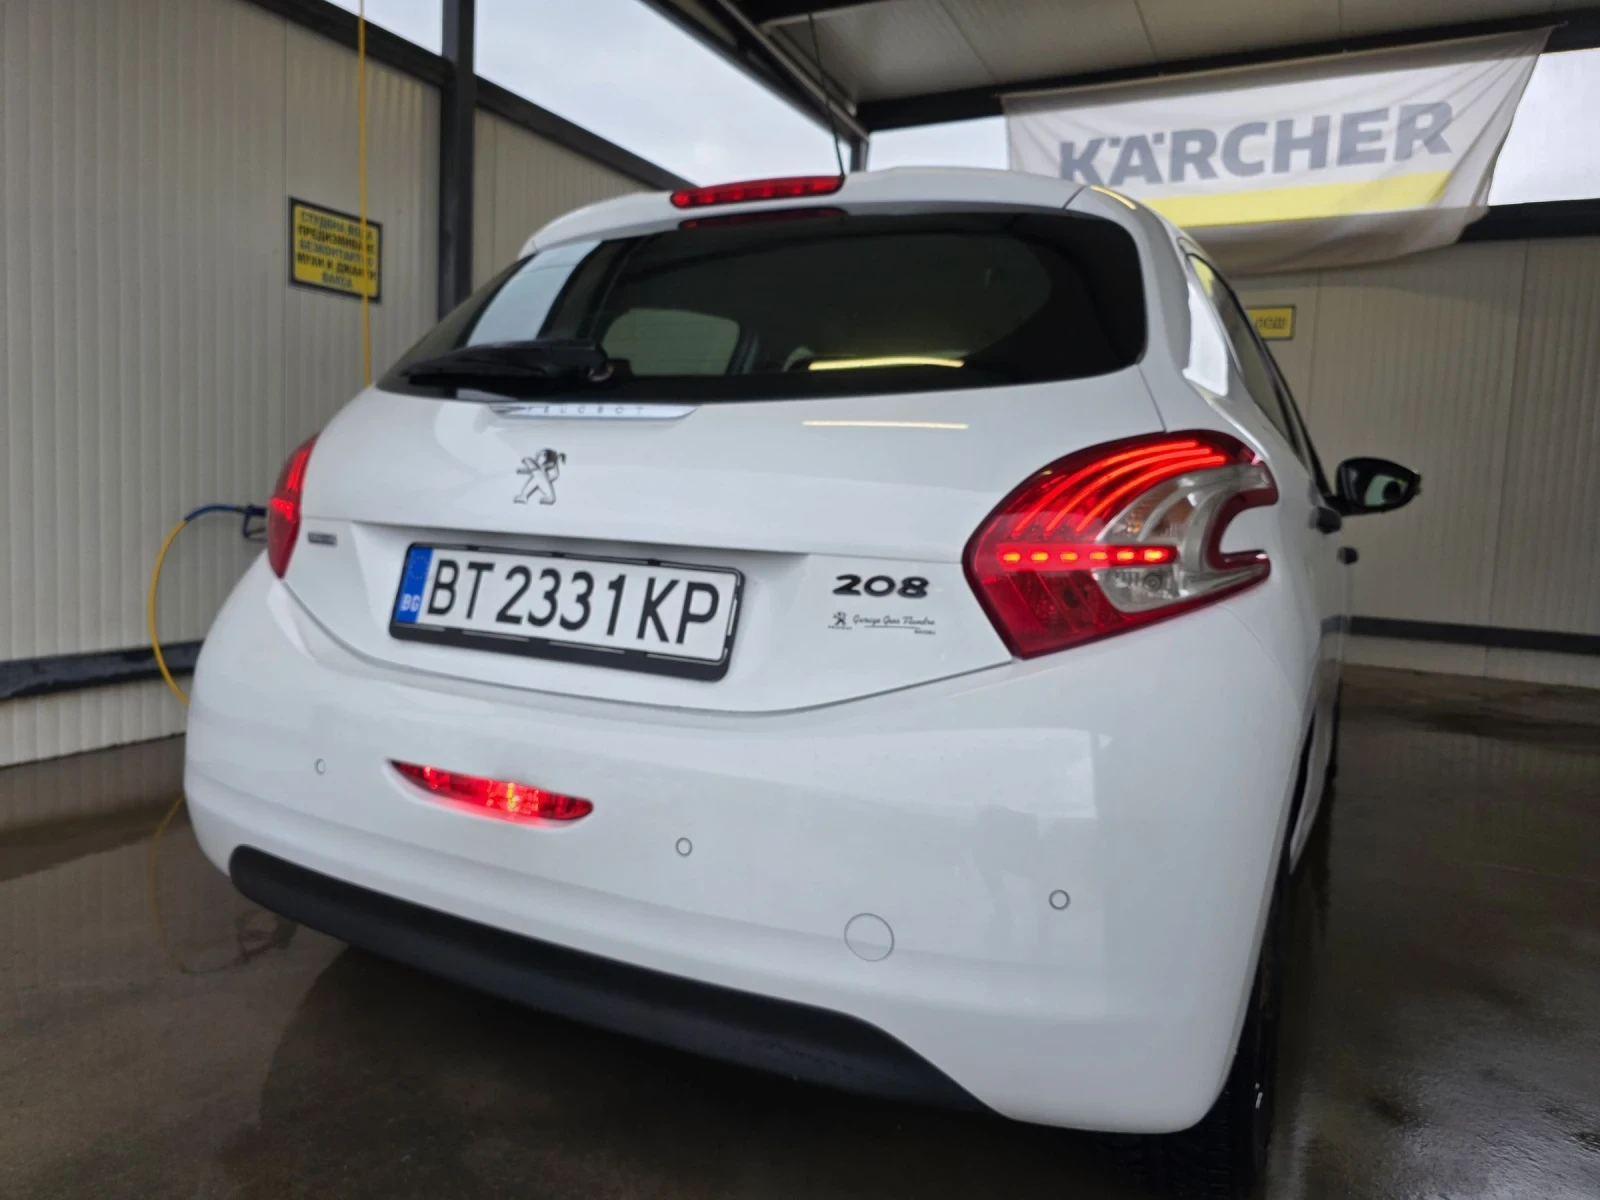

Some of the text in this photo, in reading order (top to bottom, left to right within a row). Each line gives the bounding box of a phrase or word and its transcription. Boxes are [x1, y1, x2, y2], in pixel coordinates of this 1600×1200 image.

[1059, 101, 1453, 187] KÄRCHER
[348, 222, 373, 241] ВОА
[832, 574, 930, 599] 208
[402, 593, 420, 612] BG
[427, 558, 720, 645] BT 2331 KP
